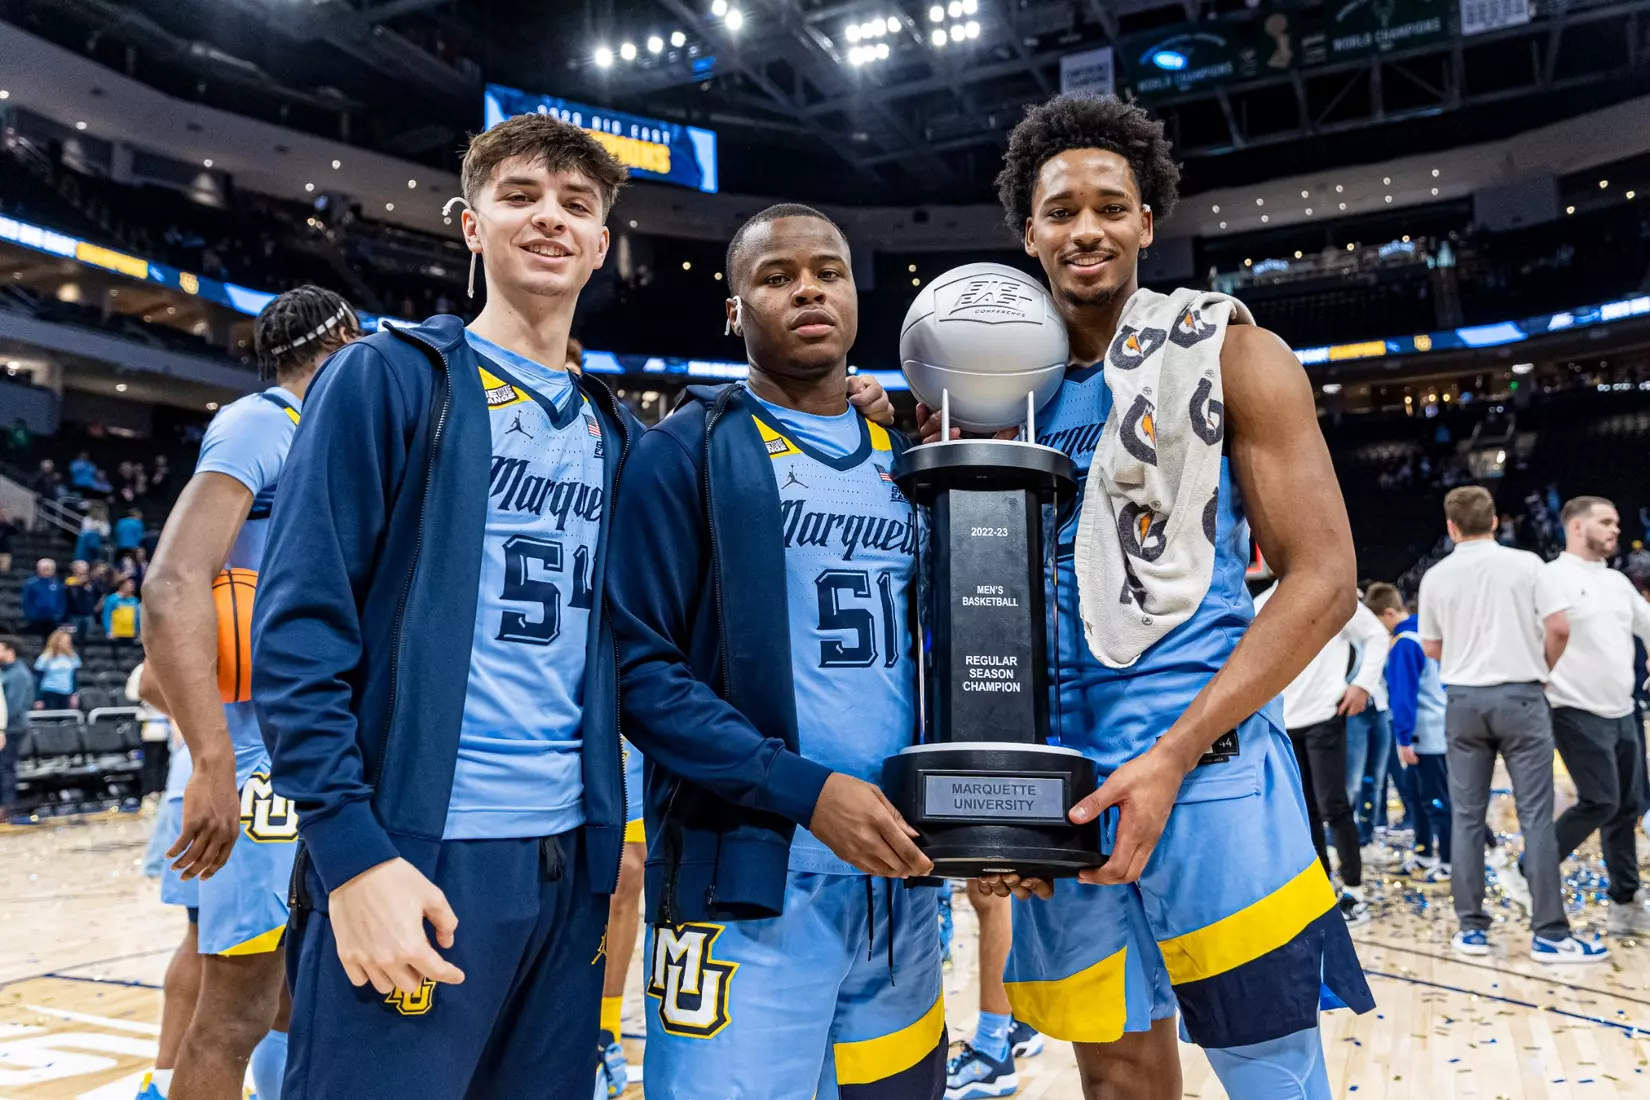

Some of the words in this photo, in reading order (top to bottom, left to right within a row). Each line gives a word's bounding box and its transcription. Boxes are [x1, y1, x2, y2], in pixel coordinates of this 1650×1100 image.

[487, 393, 517, 404] ANGE
[490, 455, 603, 531] Marque
[971, 527, 1009, 537] 2022-23
[976, 585, 1004, 595] MEN'S
[962, 596, 1019, 607] BASKETBALL
[814, 569, 900, 669] 51
[965, 655, 1018, 667] REGULAR
[969, 668, 1014, 679] SEASON
[962, 681, 1021, 693] CHAMPION
[951, 783, 1037, 796] MARQUETTE
[953, 799, 1035, 811] UNIVERSITY
[647, 920, 741, 1040] MU
